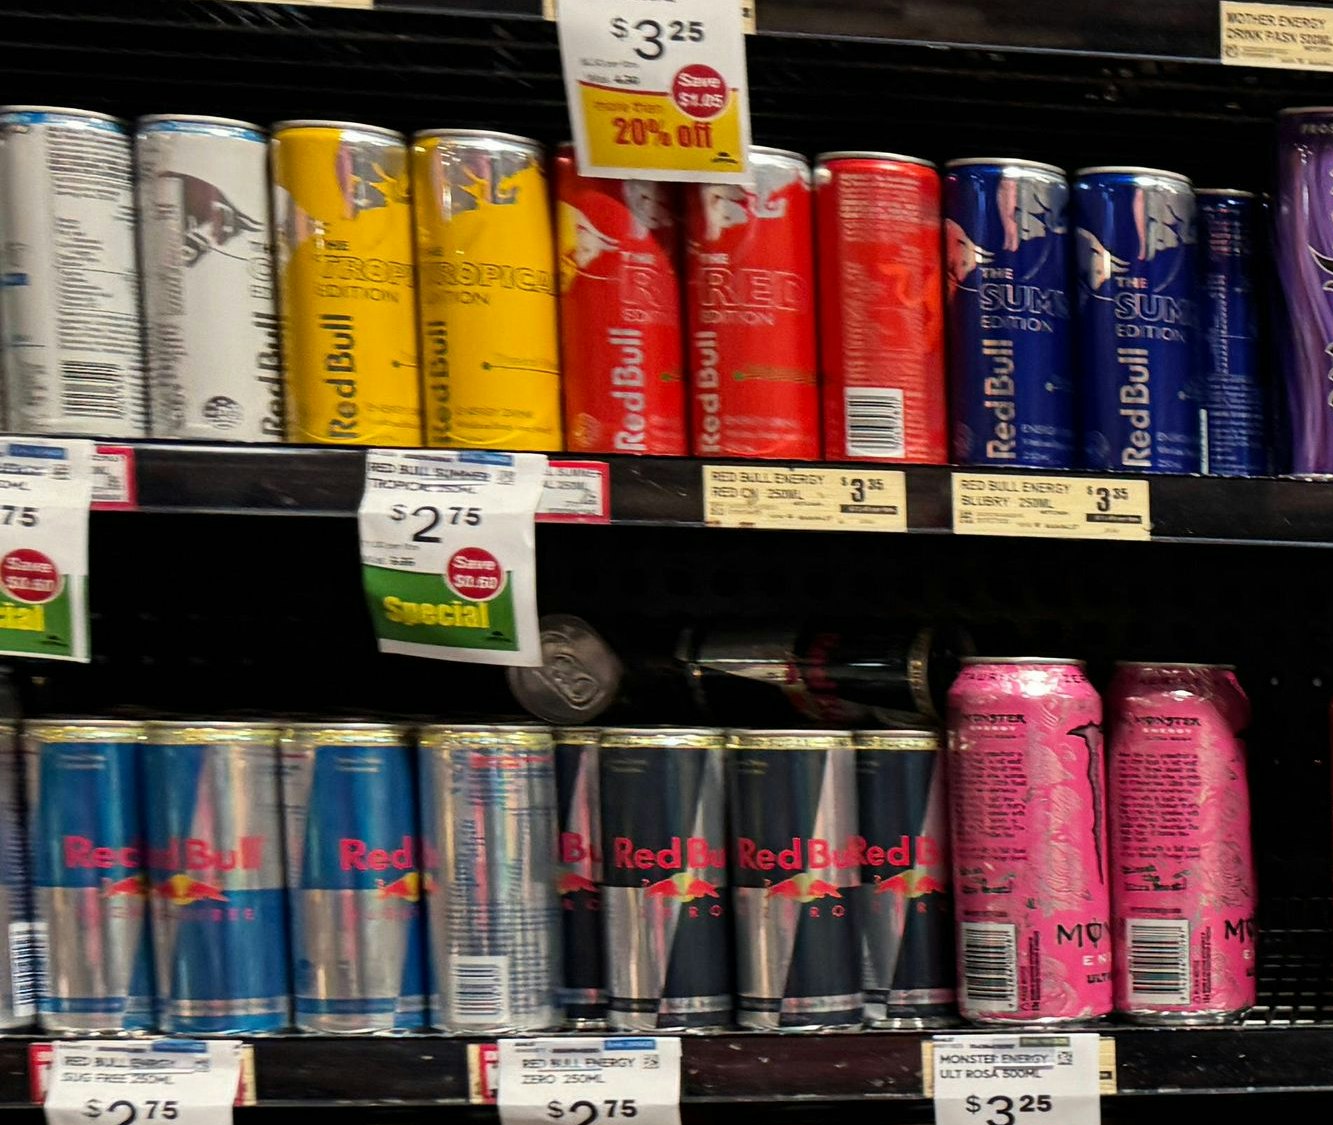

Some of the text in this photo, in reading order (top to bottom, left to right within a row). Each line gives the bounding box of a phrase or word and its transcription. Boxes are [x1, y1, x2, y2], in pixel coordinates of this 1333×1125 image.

[678, 73, 721, 89] Save
[612, 117, 714, 150] 20% off
[981, 315, 1054, 332] EDITION
[1116, 324, 1187, 342] EDITION
[983, 339, 1017, 460] Red Bull
[1117, 348, 1150, 467] Red Bull
[712, 471, 824, 487] RED BULL ENERGY
[961, 479, 1071, 496] RED BULL ENERGY
[454, 557, 495, 573] Save
[385, 595, 490, 630] Special
[615, 836, 681, 870] Red
[522, 1057, 635, 1069] RED BULL ENERGY
[940, 1055, 1047, 1065] MONSTER ENERGY
[522, 1073, 555, 1085] ZERO
[940, 1070, 963, 1079] ULT
[966, 1070, 998, 1079] ROSA
